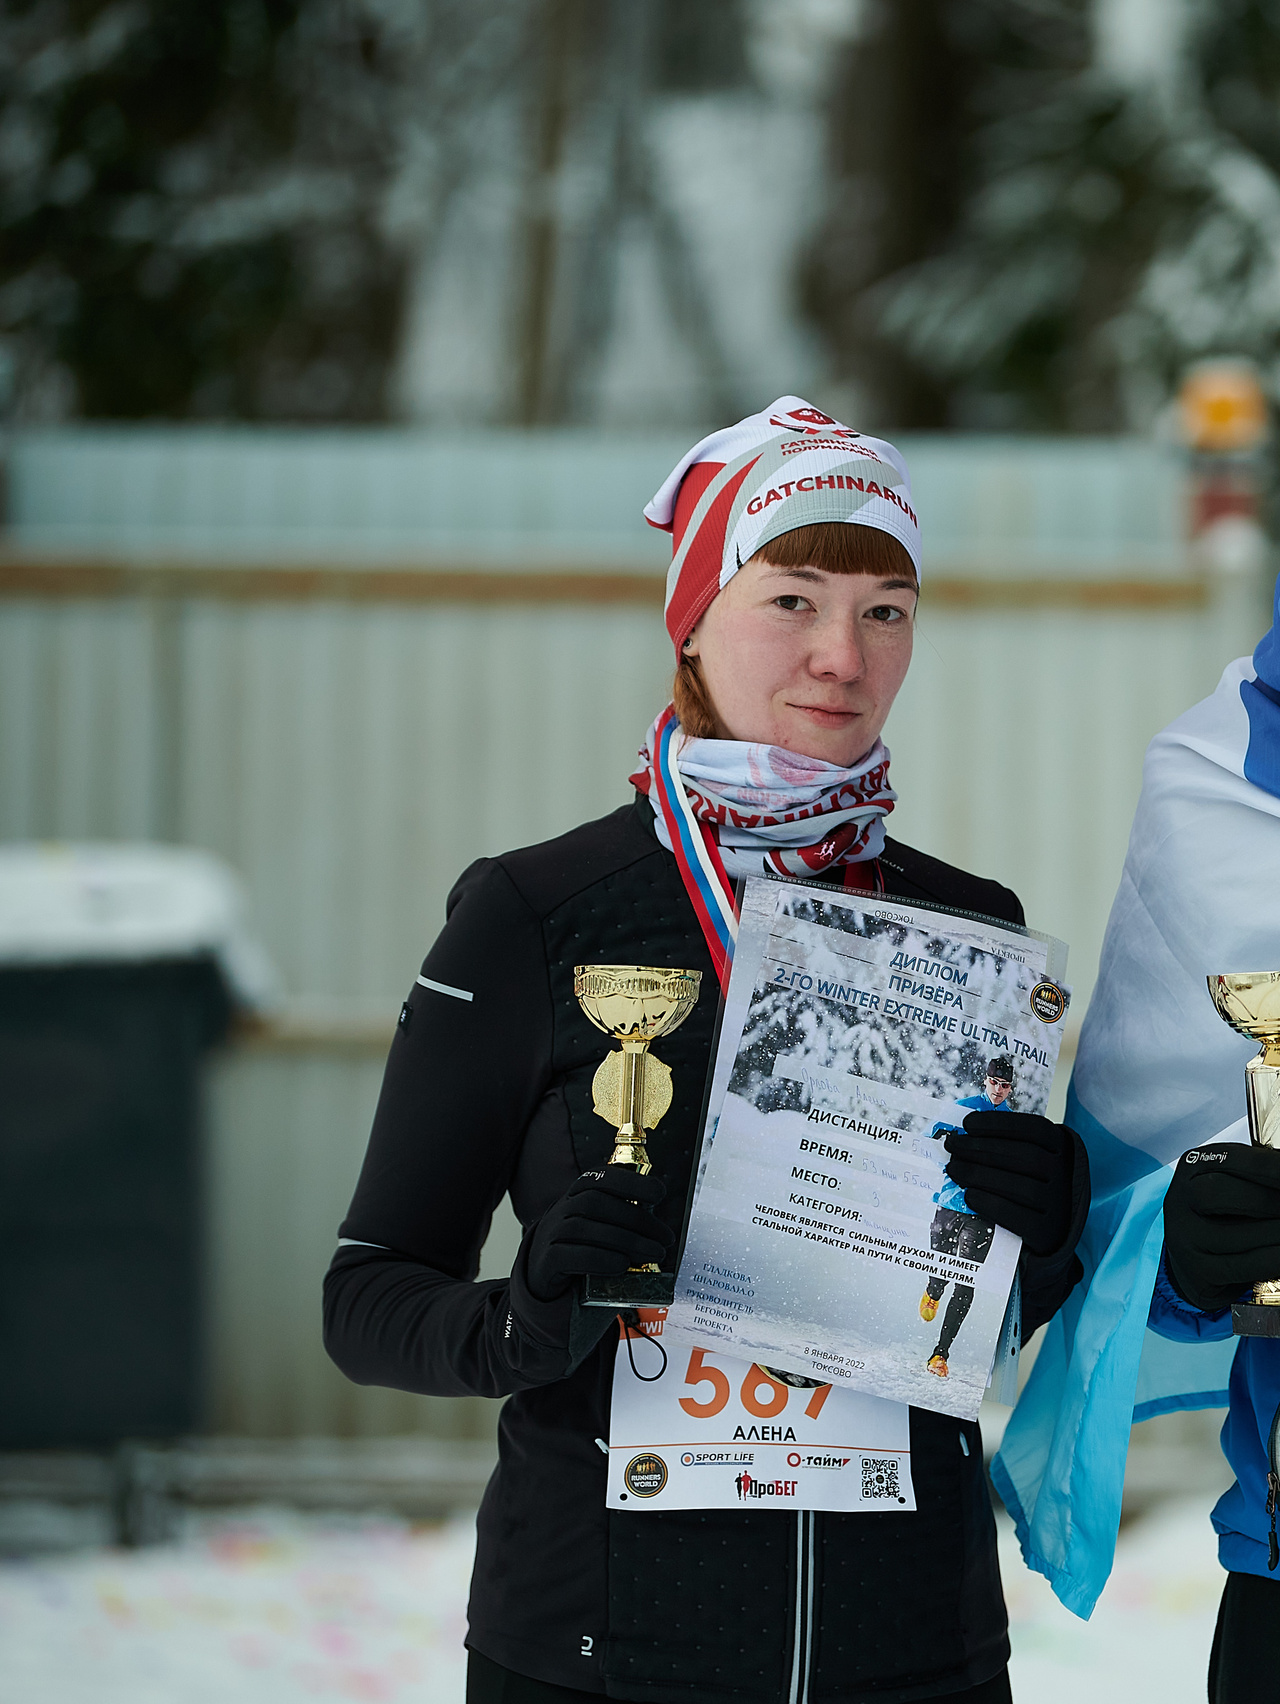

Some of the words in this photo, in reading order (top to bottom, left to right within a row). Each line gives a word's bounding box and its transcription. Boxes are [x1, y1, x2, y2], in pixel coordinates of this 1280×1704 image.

[780, 437, 878, 457] ГАТЧИНСКИЙ
[746, 474, 918, 528] GATCHINARUN
[874, 908, 915, 925] ТОКСОВО
[889, 951, 969, 987] ДИПЛОМ
[888, 974, 964, 1010] ПРИЗЁРА
[1036, 997, 1058, 1012] RUNNERS
[1036, 1004, 1055, 1016] WORLD
[775, 967, 813, 990] 2-ГО
[817, 978, 881, 1010] WINTER
[883, 998, 958, 1033] EXTREME
[961, 1021, 1010, 1051] ULTRA
[1013, 1038, 1050, 1068] TRAIL
[808, 1109, 903, 1144] ДИСТАНЦИЯ:
[799, 1138, 853, 1165] ВРЕМЯ:
[911, 1139, 921, 1153] 5
[862, 1158, 877, 1174] 53
[1200, 1152, 1228, 1163] Kalenji
[790, 1166, 843, 1191] МЕСТО:
[789, 1192, 863, 1223] КАТЕГОРИЯ:
[873, 1191, 880, 1207] 3
[754, 1203, 798, 1223] ЧЕЛОВЕК
[798, 1216, 845, 1236] ЯВЛЯЕТСЯ
[848, 1230, 898, 1251] СИЛЬНЫМ
[898, 1244, 935, 1261] ДУХОМ
[938, 1255, 947, 1264] И
[948, 1258, 980, 1273] ИМЕЕТ
[752, 1216, 803, 1237] СТАЛЬНОЙ
[803, 1231, 851, 1250] ХАРАКТЕР
[851, 1244, 866, 1255] НА
[867, 1248, 893, 1262] ПУТИ
[894, 1256, 901, 1265] К
[902, 1258, 938, 1275] СВОИМ
[939, 1268, 976, 1285] ЦЕЛЯМ.
[702, 1263, 752, 1284] ГЛАДКОВА
[686, 1288, 754, 1314] РУКОВОДИТЕЛЬ
[695, 1304, 739, 1322] БЕГОВОГО
[504, 1311, 513, 1338] WATC
[693, 1316, 734, 1334] ПРОЕКТА
[804, 1347, 810, 1356] 8
[810, 1348, 845, 1364] ЯНВАРЯ
[845, 1357, 866, 1370] 2022
[811, 1360, 852, 1379] ТОКСОВО
[732, 1425, 797, 1442] АЛЕНА
[695, 1453, 732, 1461] SPORT
[749, 1480, 798, 1498] ПроБЕГ
